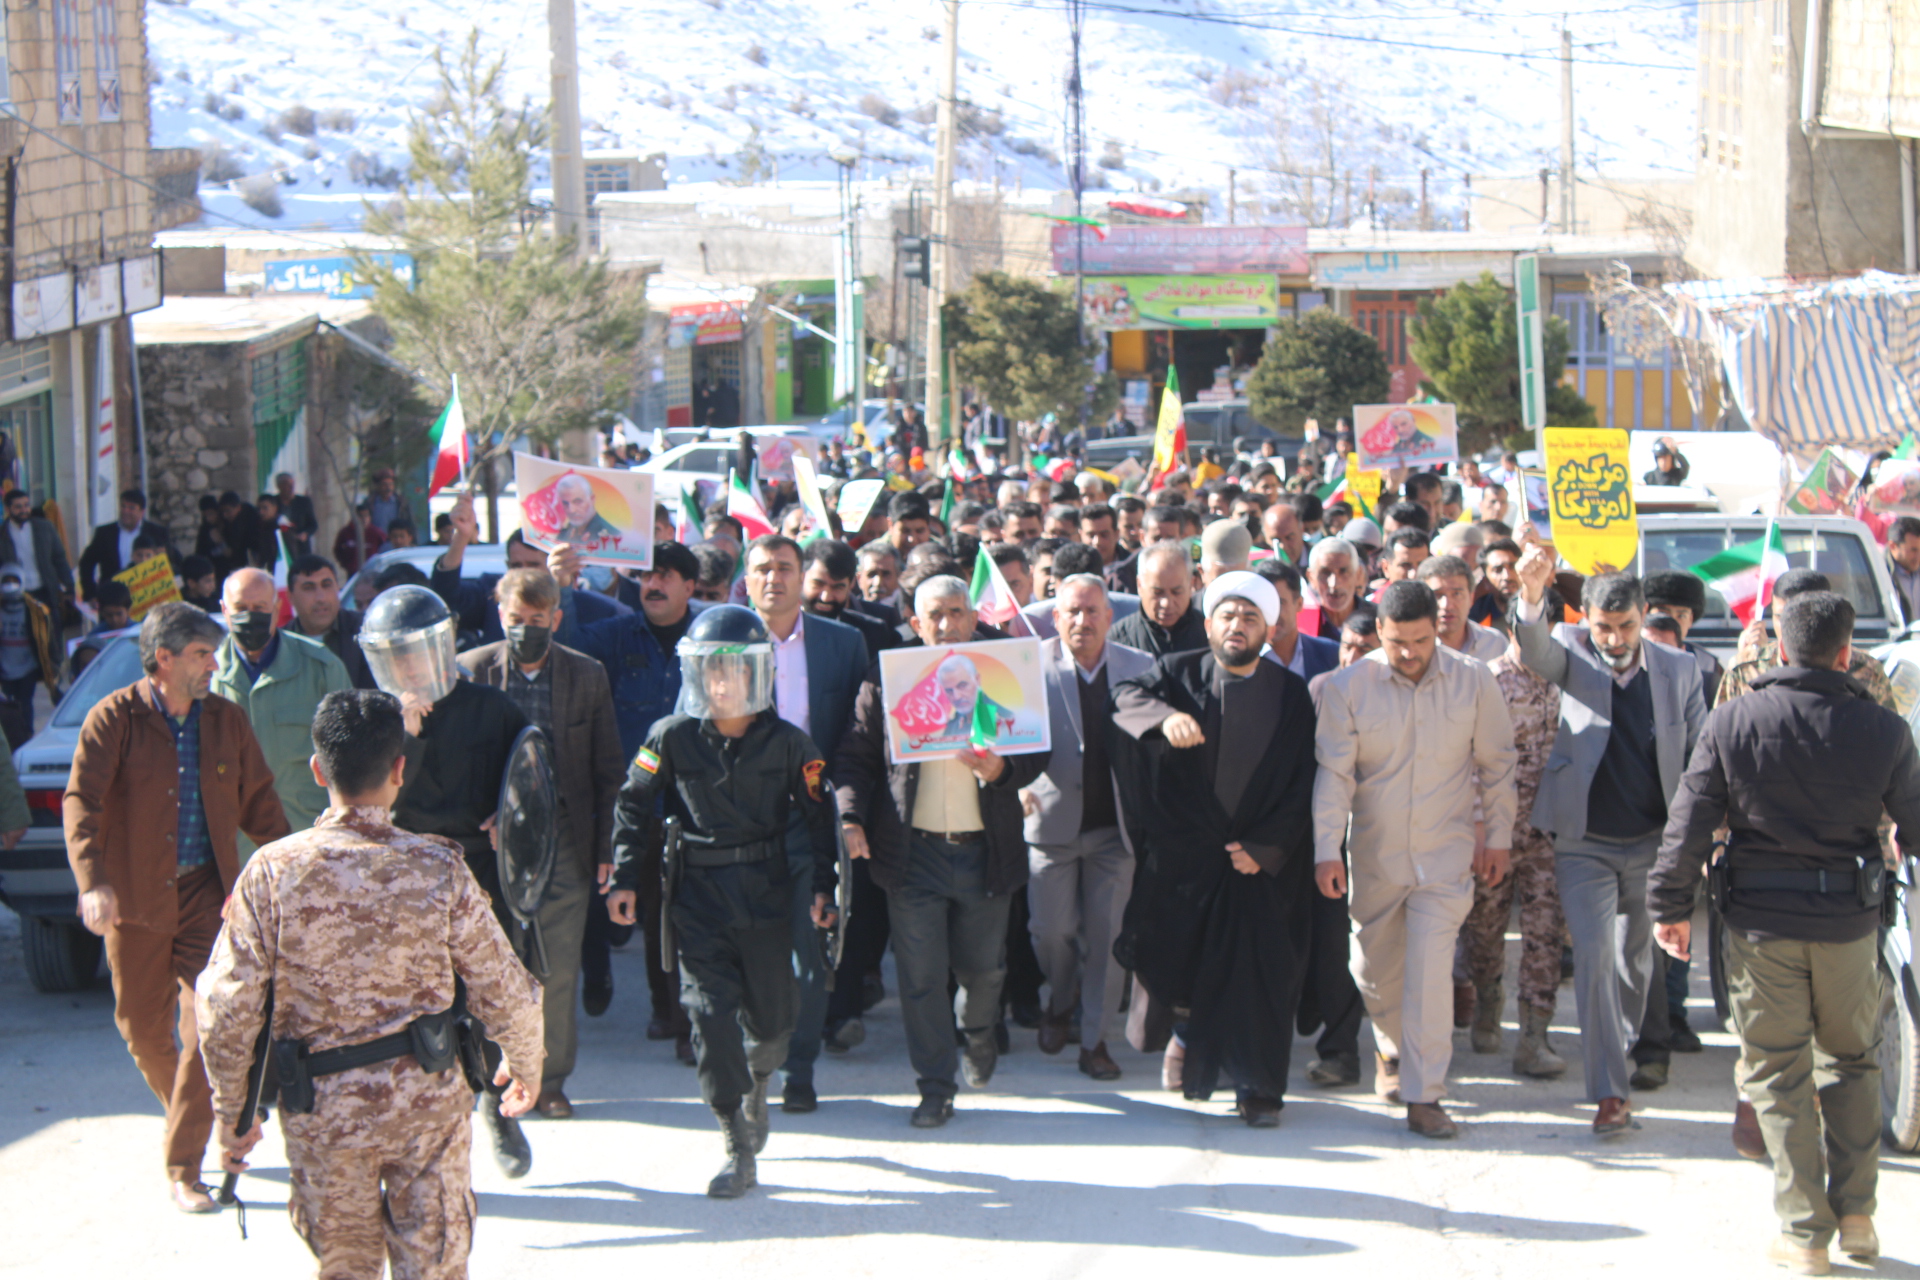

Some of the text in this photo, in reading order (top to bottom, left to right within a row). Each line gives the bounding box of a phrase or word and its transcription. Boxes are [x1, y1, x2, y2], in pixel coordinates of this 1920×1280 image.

[273, 264, 340, 295] پوشاک
[1143, 279, 1266, 302] فروشگاه مواد غذایی
[1554, 454, 1626, 491] مرگ بر
